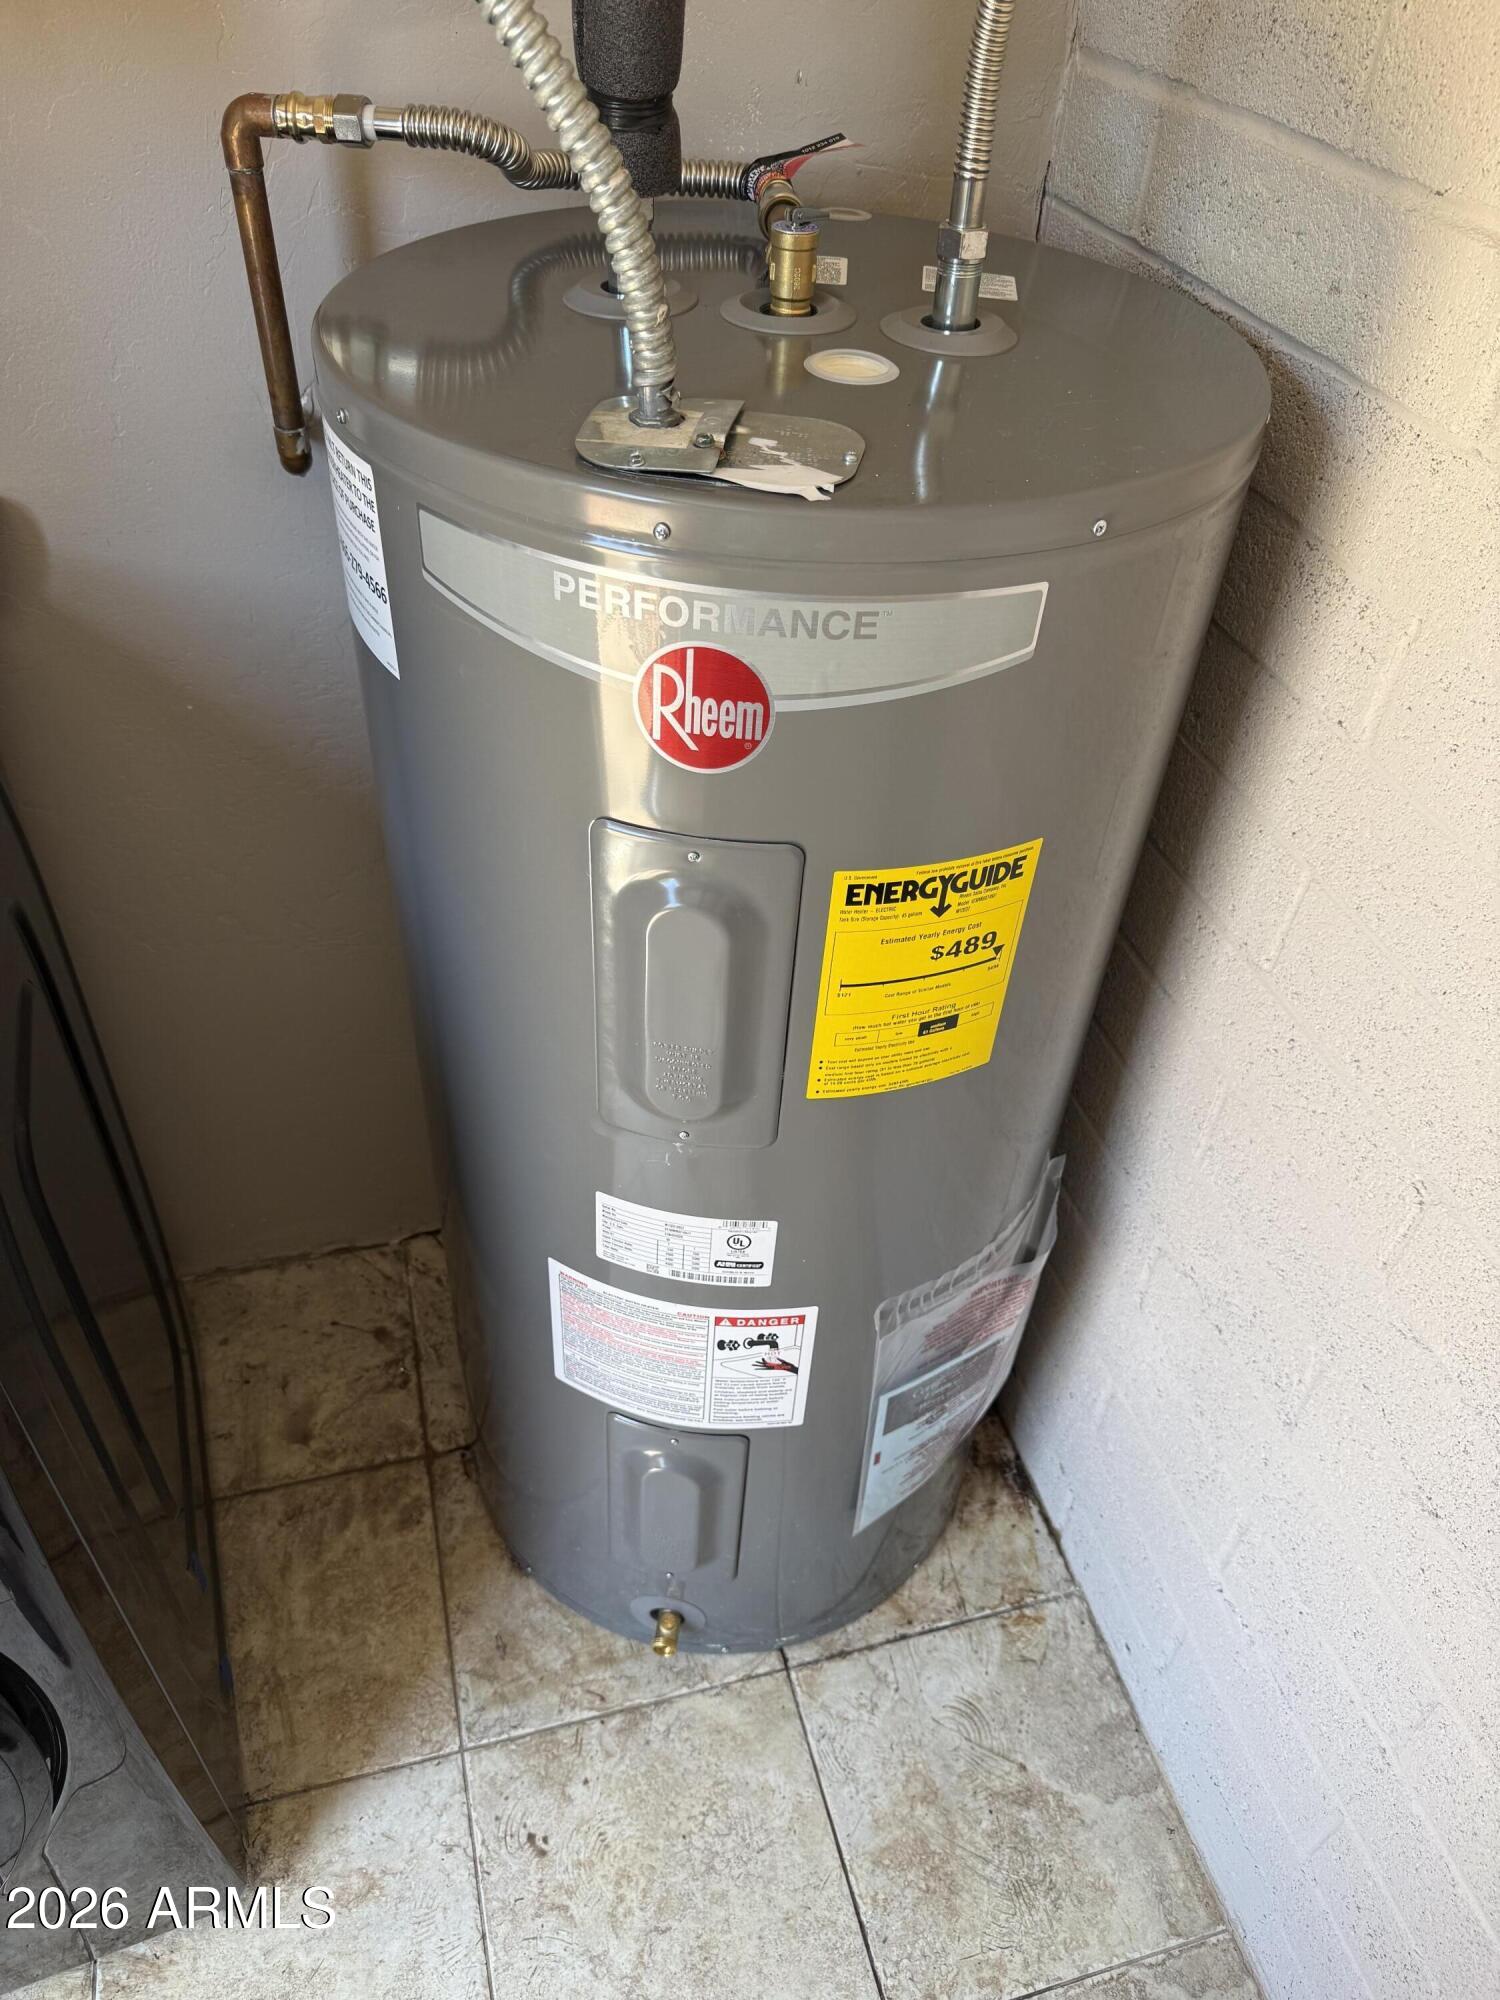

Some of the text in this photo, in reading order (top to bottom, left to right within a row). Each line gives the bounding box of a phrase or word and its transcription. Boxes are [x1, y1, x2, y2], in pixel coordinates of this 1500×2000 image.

[356, 469, 373, 491] THIS
[344, 493, 376, 534] PURCHASE
[353, 484, 362, 502] TO
[362, 493, 376, 514] THE
[652, 648, 763, 751] Rheem
[846, 855, 1027, 917] ENERGYGUIDE
[880, 922, 982, 945] Estimated Yearly Energy Cost
[930, 931, 997, 961] $489
[932, 1003, 957, 1013] Rating
[737, 1317, 799, 1326] DANGER
